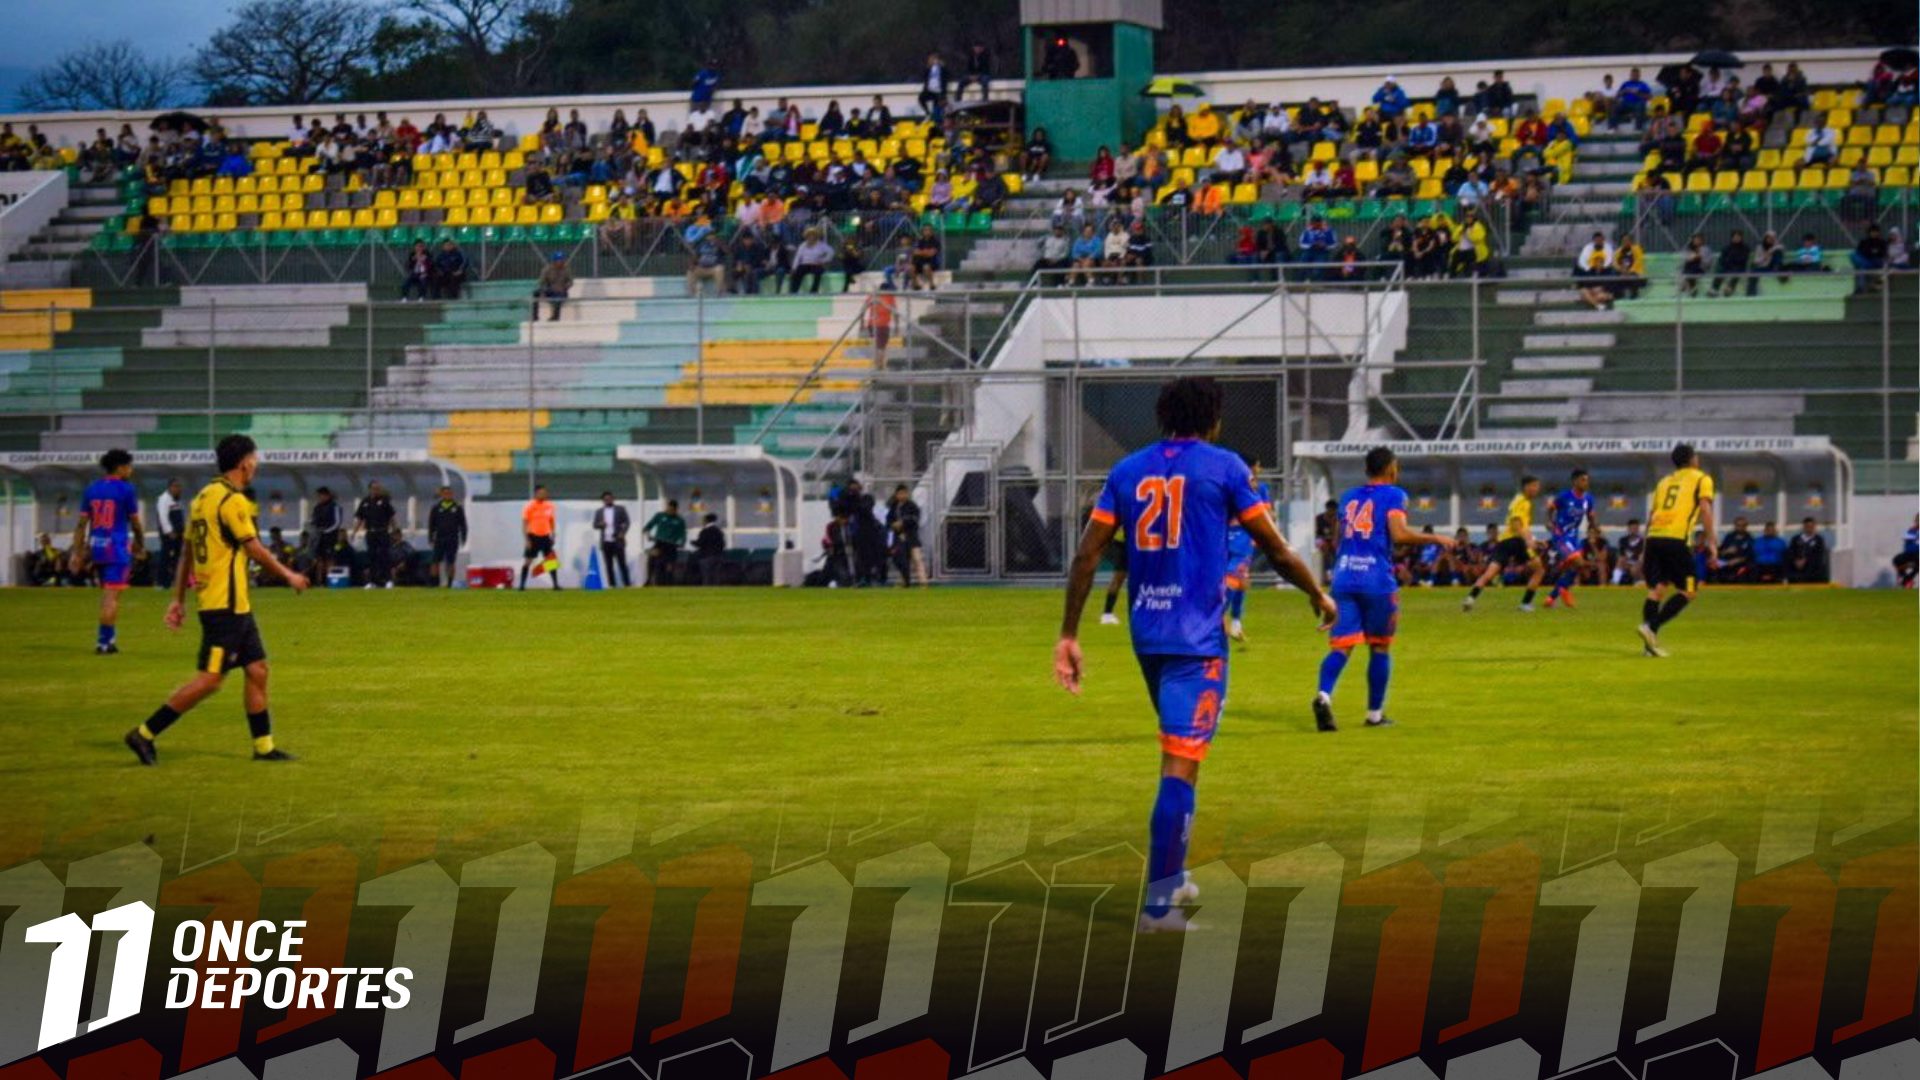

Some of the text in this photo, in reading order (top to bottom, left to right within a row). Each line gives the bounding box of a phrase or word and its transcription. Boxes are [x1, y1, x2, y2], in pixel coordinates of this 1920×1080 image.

[1530, 441, 1575, 451] PARA
[1136, 475, 1185, 551] 21
[1662, 485, 1680, 510] 6
[1344, 499, 1374, 540] 14
